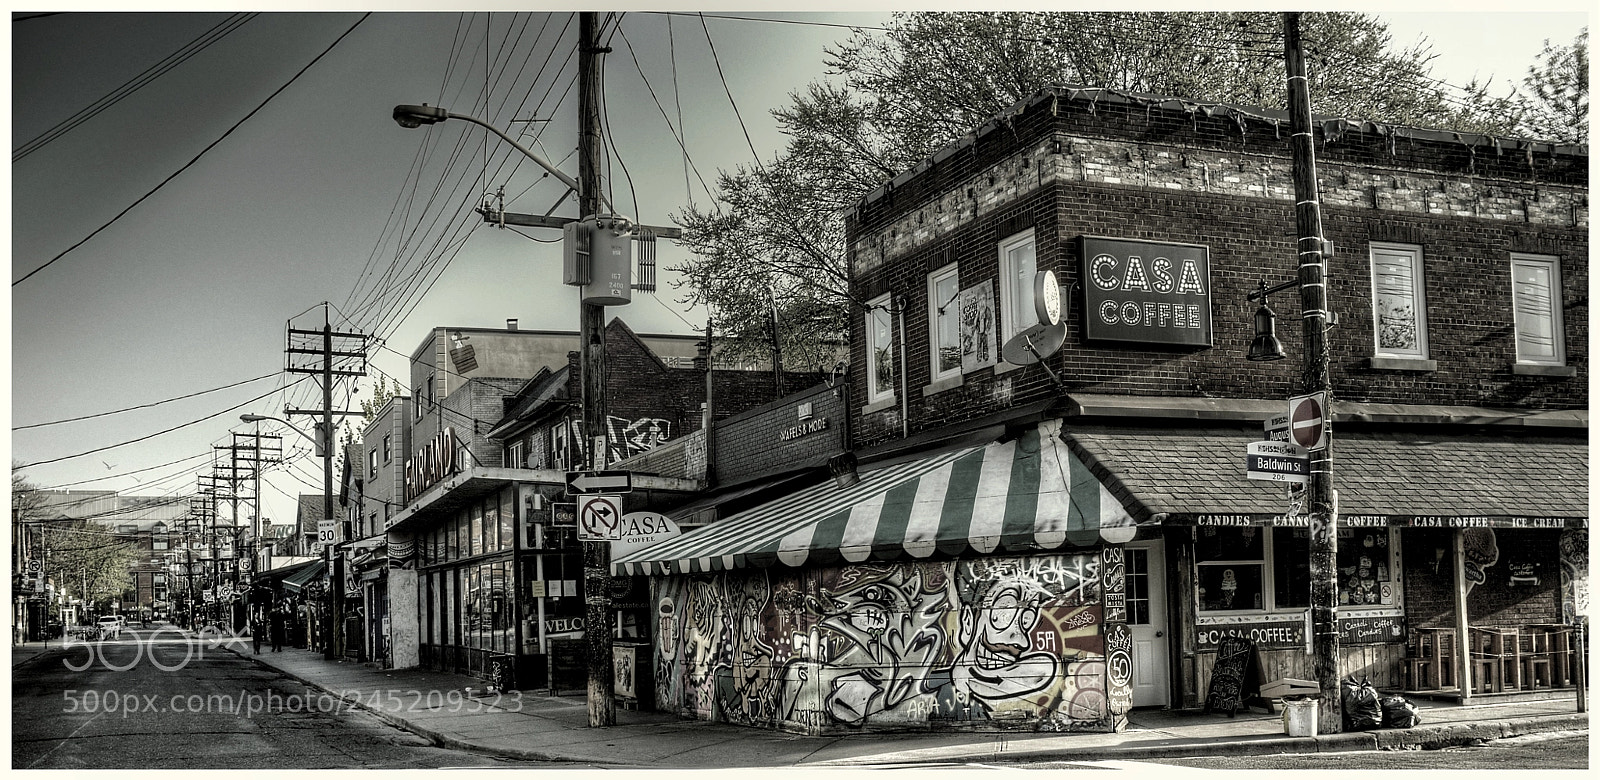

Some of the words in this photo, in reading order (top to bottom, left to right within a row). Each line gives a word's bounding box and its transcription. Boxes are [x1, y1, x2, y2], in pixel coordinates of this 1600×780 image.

[1090, 253, 1206, 295] CASA
[1098, 299, 1201, 329] COFFEE
[780, 425, 802, 441] WAFELS
[802, 423, 807, 435] &
[808, 417, 826, 433] MORE
[1257, 457, 1292, 472] Baldwin
[1293, 462, 1301, 472] St
[1197, 515, 1250, 526] CANDIES
[1273, 515, 1310, 526] CANNO
[1346, 516, 1387, 526] COFFEE
[1413, 516, 1443, 527] CASA
[1448, 516, 1488, 527] COFFEE
[1512, 518, 1528, 527] ICE
[1533, 518, 1565, 528] CREAM
[320, 530, 335, 542] 30
[627, 536, 656, 544] COFFEE
[1103, 547, 1124, 564] CASA
[1107, 629, 1131, 647] CASA
[1250, 627, 1293, 643] COFFEE
[1108, 639, 1132, 652] COFFEE
[1113, 657, 1129, 679] 50
